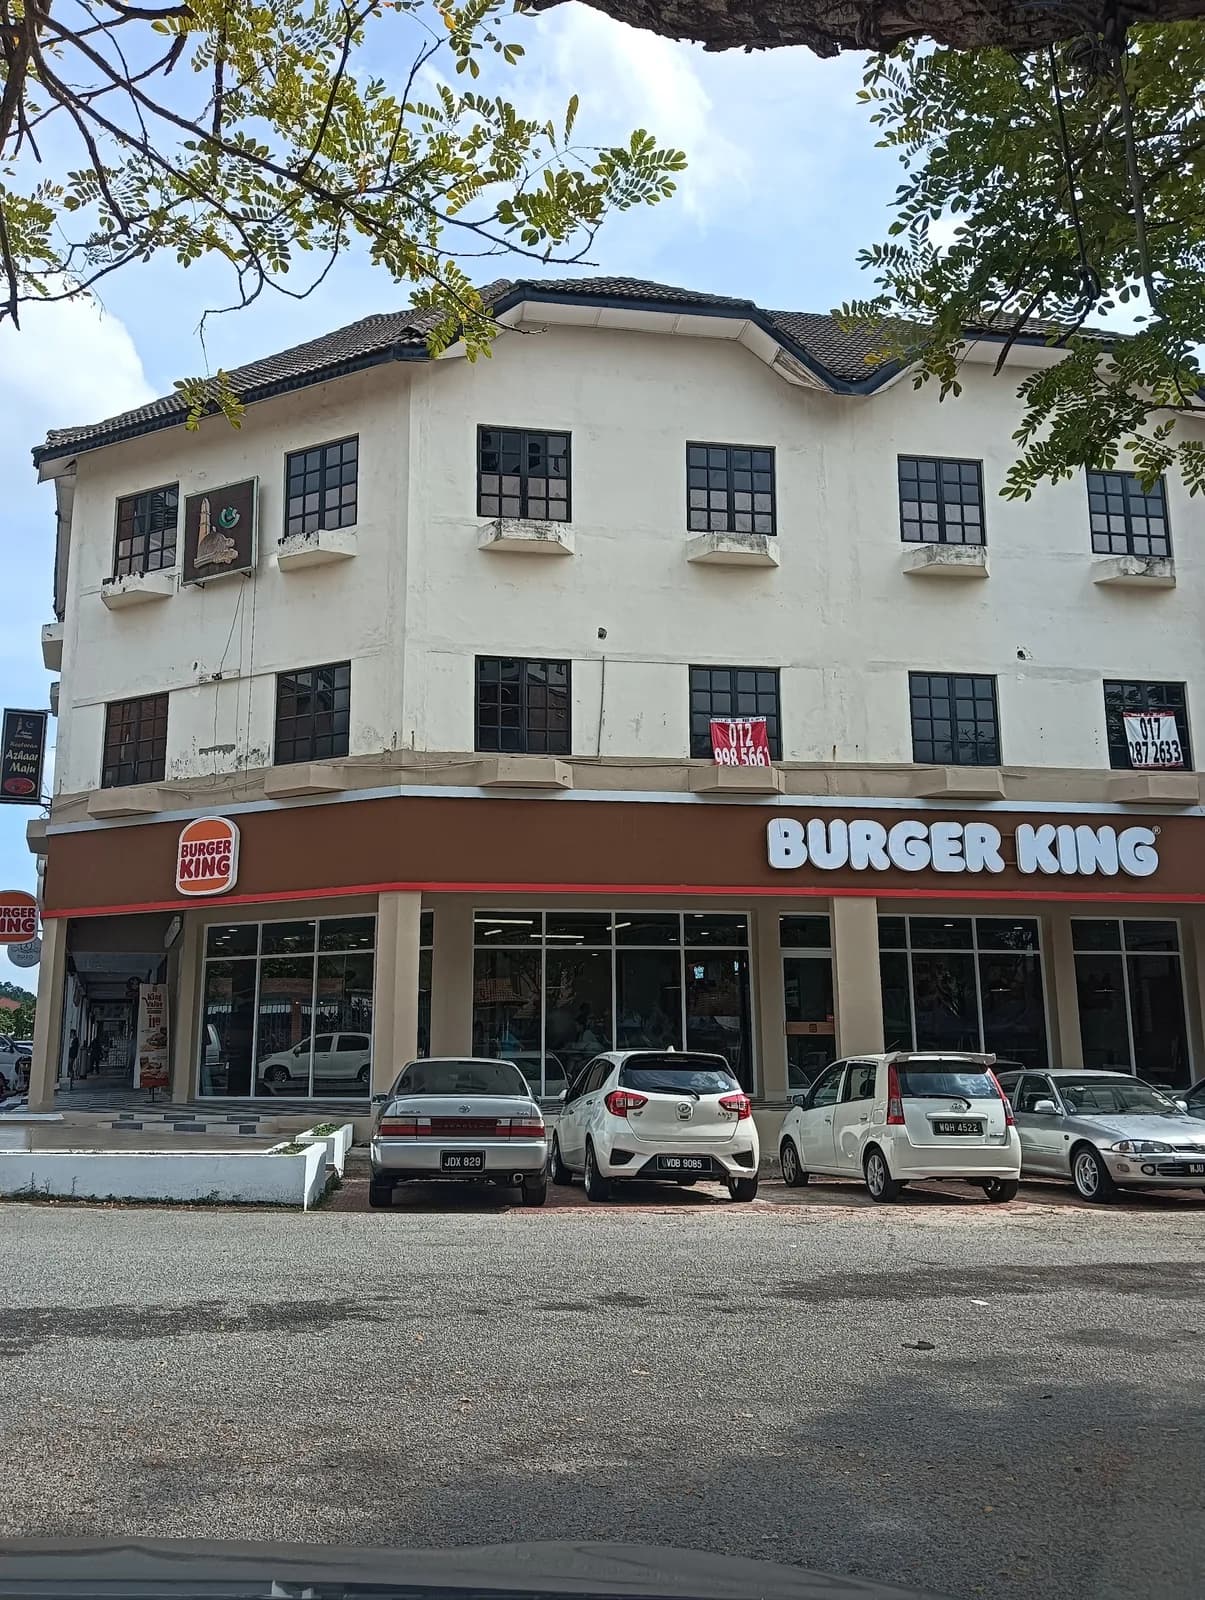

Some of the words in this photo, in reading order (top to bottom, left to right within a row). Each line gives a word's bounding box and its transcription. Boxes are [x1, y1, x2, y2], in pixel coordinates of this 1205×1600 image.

[728, 723, 754, 747] 012
[1139, 717, 1161, 741] 017
[714, 746, 739, 766] 998
[1129, 741, 1149, 763] 287
[1151, 739, 1181, 763] 2633
[9, 762, 36, 775] Maju
[181, 840, 232, 858] BURGER
[766, 817, 1005, 874] BURGER
[1015, 823, 1160, 877] KING
[180, 855, 231, 879] KING
[938, 1122, 955, 1132] WQH
[957, 1123, 978, 1132] 4522
[444, 1156, 461, 1167] JDX
[463, 1156, 481, 1167] 829
[665, 1158, 681, 1168] VDB
[682, 1159, 703, 1169] 9085
